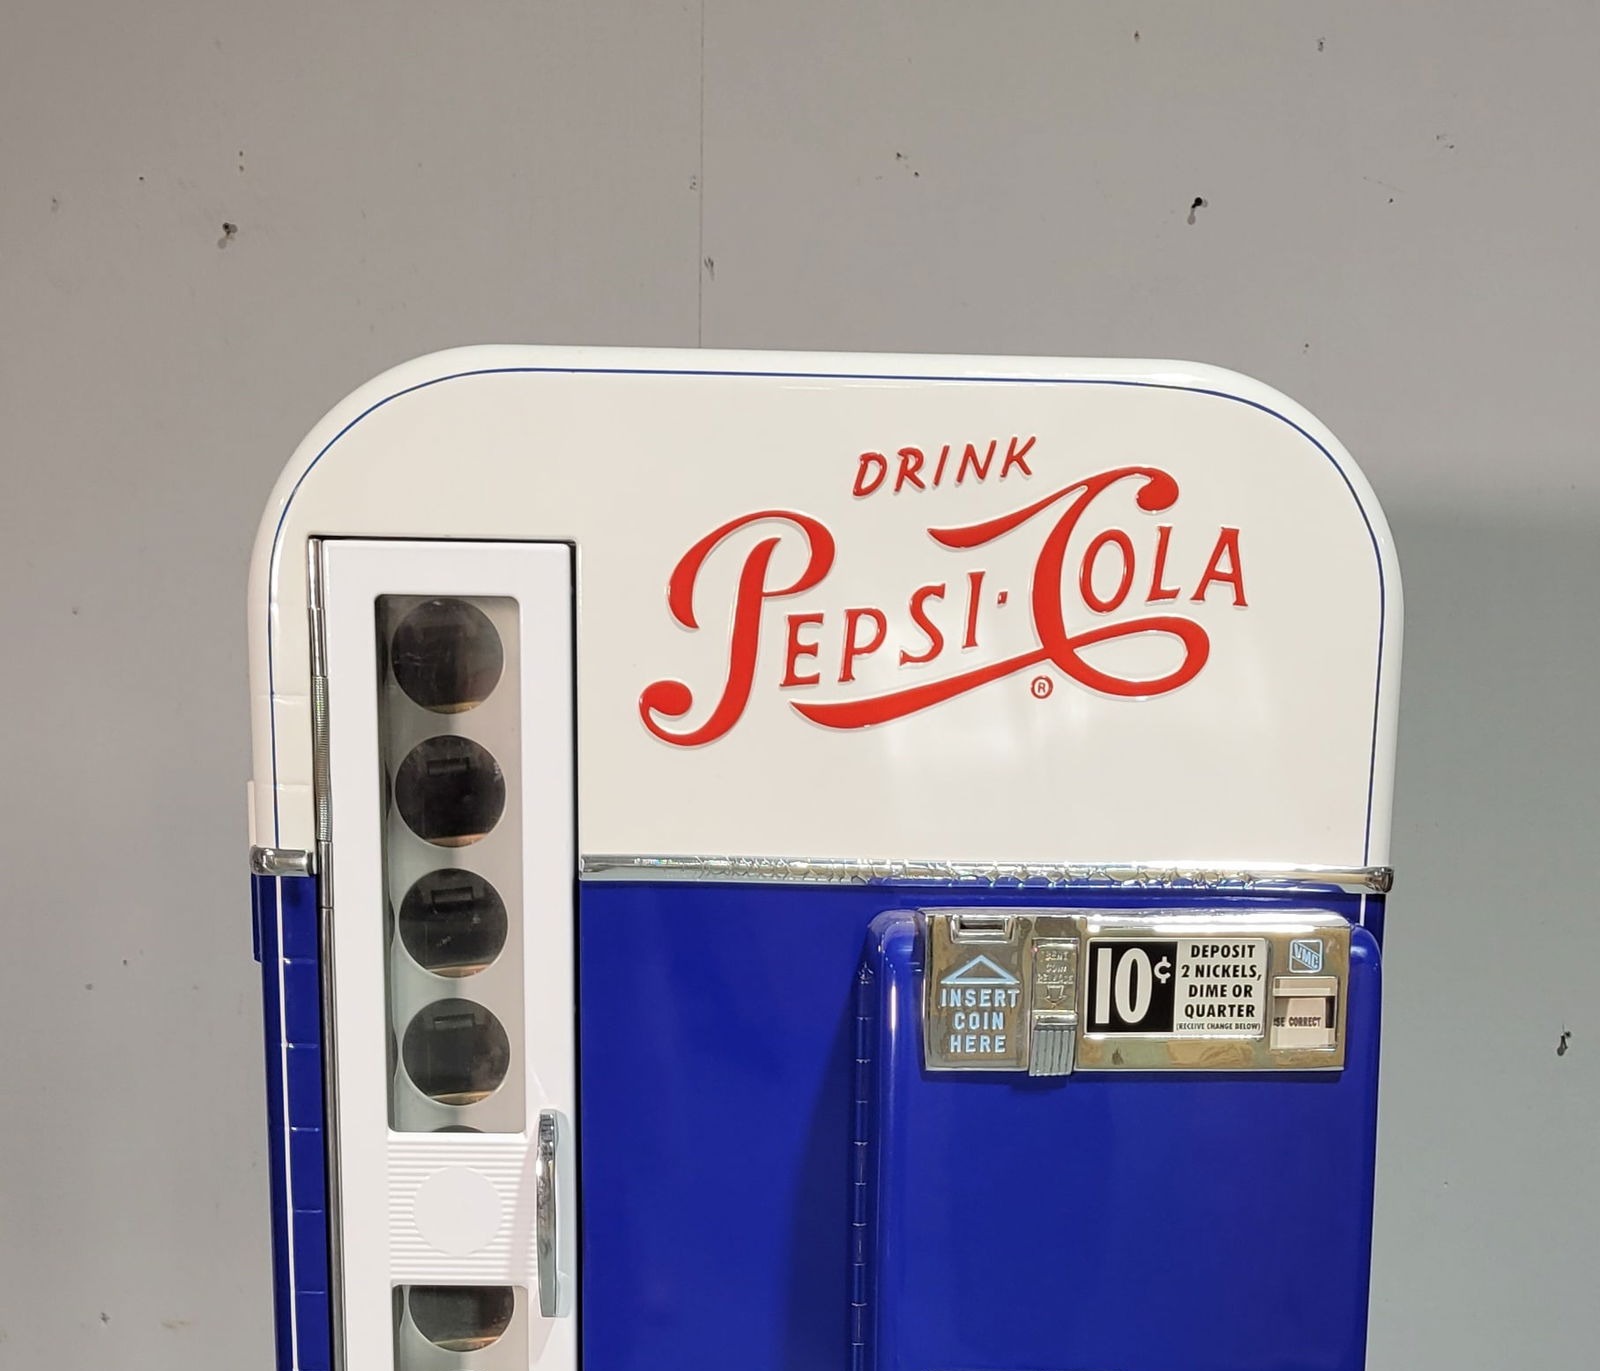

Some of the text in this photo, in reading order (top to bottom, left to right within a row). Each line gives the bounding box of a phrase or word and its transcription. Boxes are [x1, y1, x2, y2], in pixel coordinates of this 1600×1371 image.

[852, 436, 1037, 497] DRINK
[1190, 944, 1256, 958] DEPOSIT
[1293, 942, 1319, 969] VMC
[1181, 964, 1262, 981] 2 NICKELS,
[1095, 947, 1172, 1024] 10¢
[1188, 984, 1253, 998] DIME OR
[941, 988, 1020, 1008] INSERT
[1184, 1004, 1256, 1018] QUARTER
[954, 1011, 1004, 1030] COIN
[1206, 1022, 1233, 1030] CHANGE
[1288, 1016, 1322, 1027] CORRECT
[950, 1034, 1006, 1053] HERE
